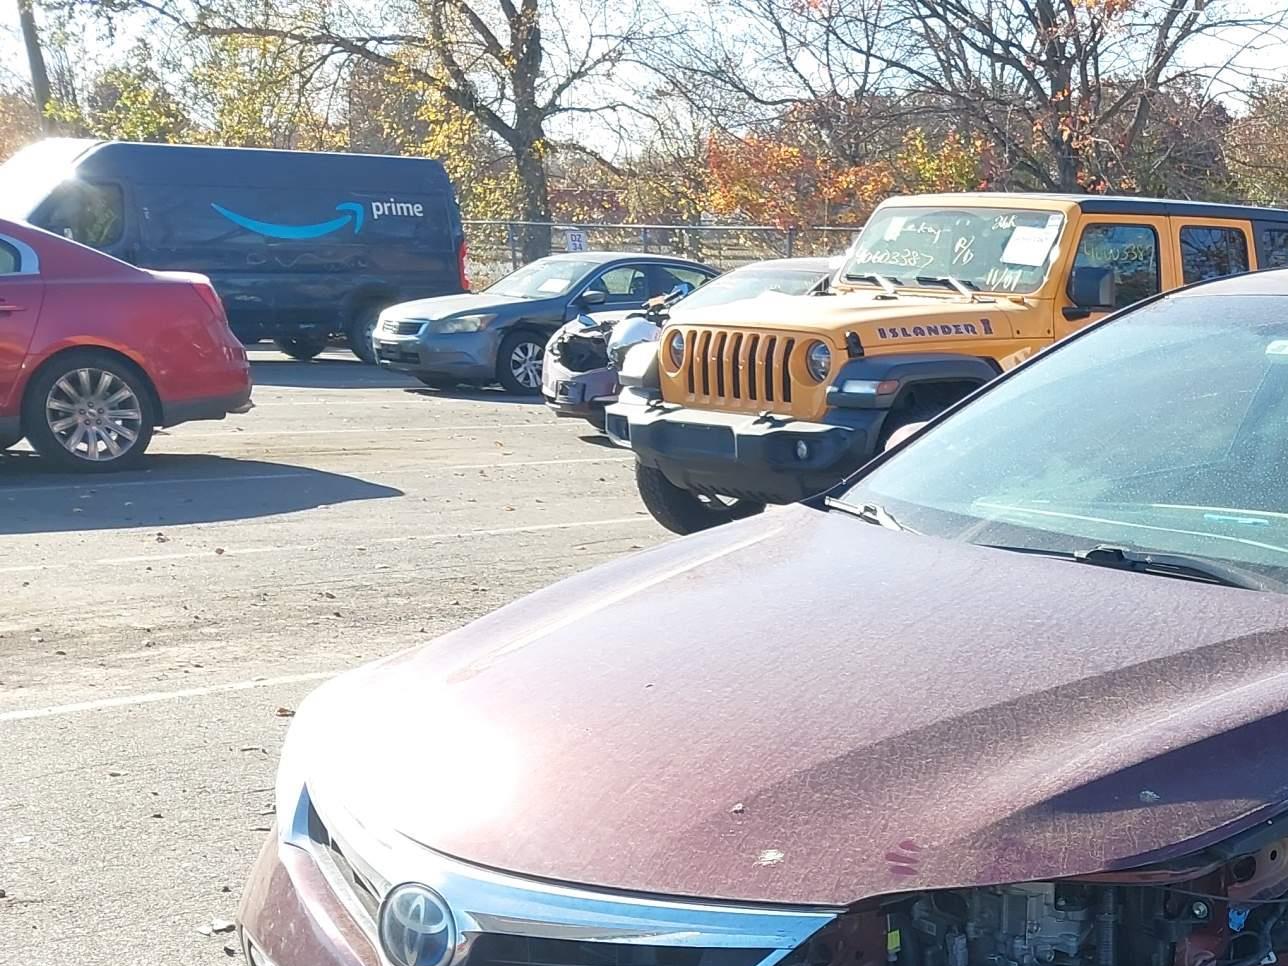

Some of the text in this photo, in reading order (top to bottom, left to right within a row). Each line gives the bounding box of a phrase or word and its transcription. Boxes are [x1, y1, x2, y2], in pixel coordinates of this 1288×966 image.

[371, 199, 424, 219] prime
[570, 233, 583, 243] DZ
[877, 323, 977, 340] ISLANDER
